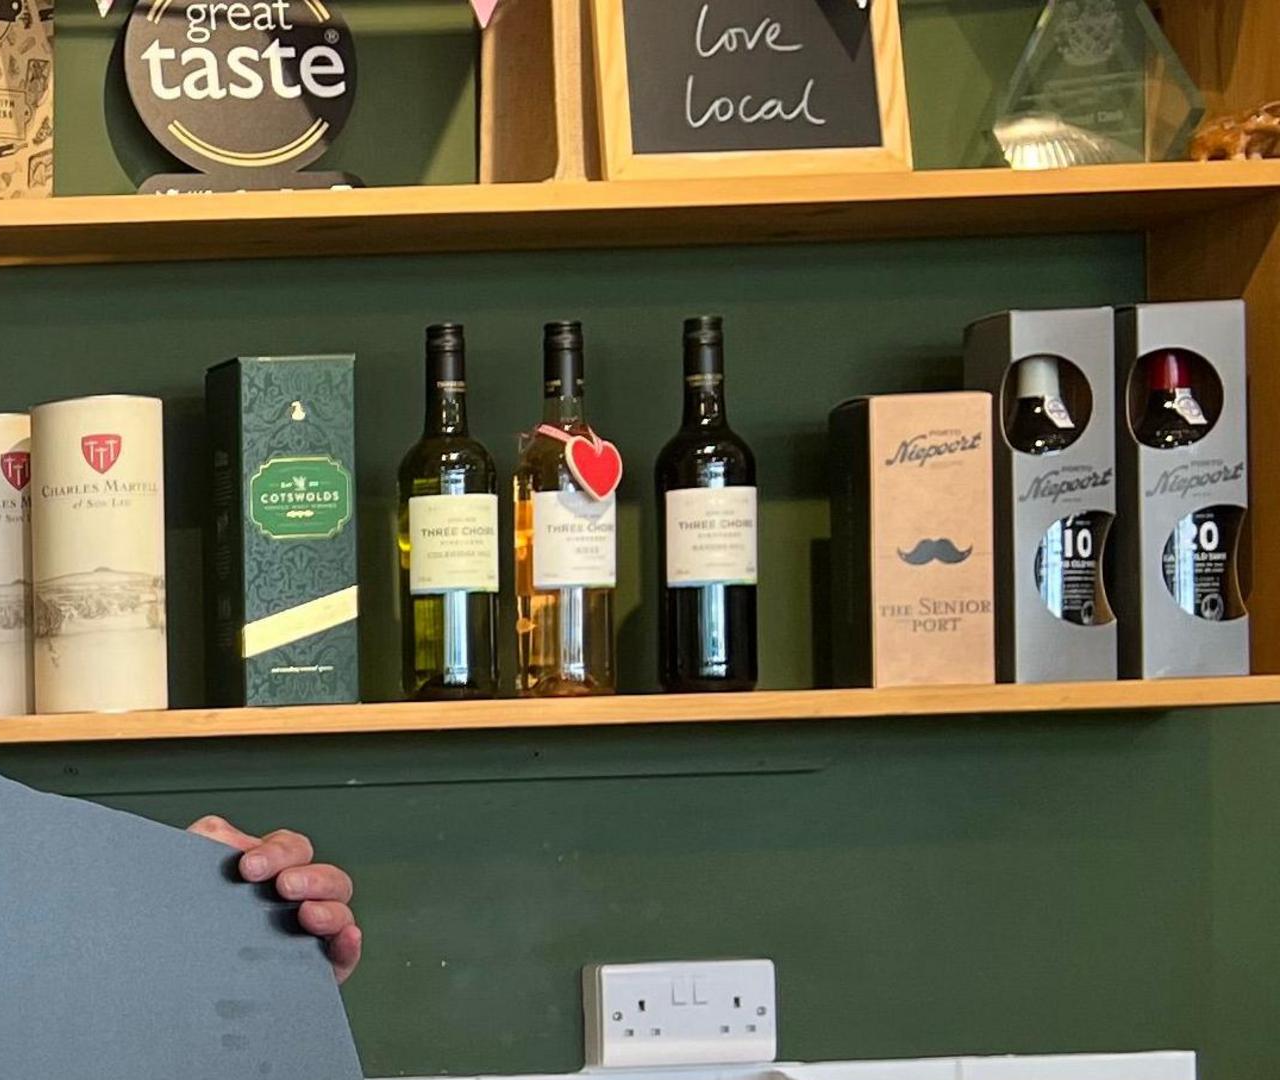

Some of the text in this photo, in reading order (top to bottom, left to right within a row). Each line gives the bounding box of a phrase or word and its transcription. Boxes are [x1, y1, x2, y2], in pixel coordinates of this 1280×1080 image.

[186, 0, 292, 43] great
[141, 38, 346, 100] taste
[885, 432, 982, 468] Niepoort
[42, 478, 158, 498] CHARLES MARTELL
[1019, 467, 1112, 503] Niepoort
[1146, 462, 1243, 498] Niepoort
[260, 490, 340, 504] COTSWOLDS
[421, 527, 458, 537] THREE
[547, 523, 584, 533] THREE
[678, 519, 716, 530] THREE
[1064, 528, 1092, 558] 10
[880, 599, 992, 617] THE SENIOR
[912, 618, 961, 633] PORT
